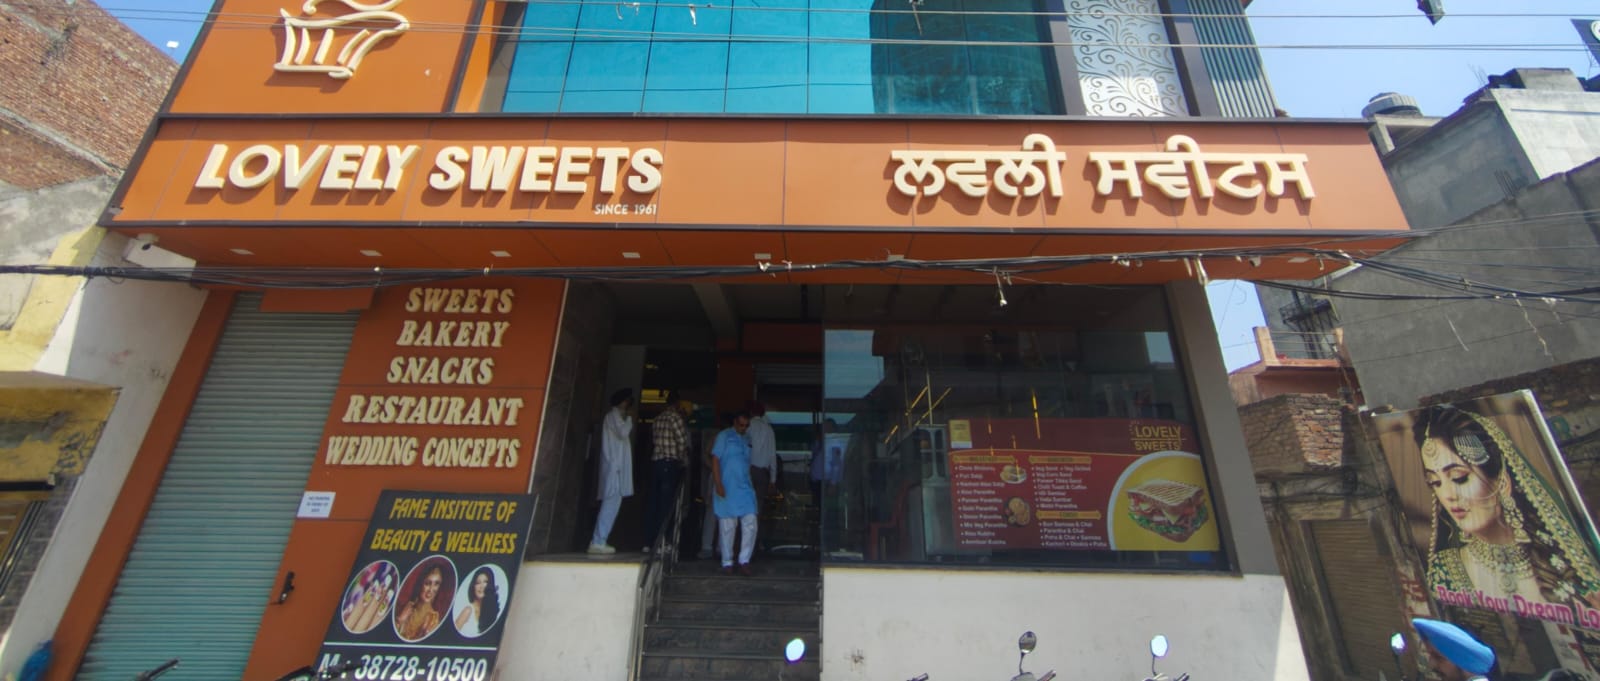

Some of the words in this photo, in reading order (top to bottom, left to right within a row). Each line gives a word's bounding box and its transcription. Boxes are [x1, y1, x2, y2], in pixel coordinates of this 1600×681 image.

[195, 143, 421, 191] LOVELY
[428, 146, 664, 194] SWEETS
[891, 133, 1067, 199] ਲਵਲੀ
[1088, 134, 1317, 200] ਸਵੀਟਸ
[594, 203, 629, 216] SINCE
[633, 203, 658, 216] 1961
[405, 287, 515, 314] SWEETS
[396, 320, 510, 348] BAKERY
[386, 356, 495, 385] SNACKS
[342, 394, 524, 427] RESTAURANT
[1135, 425, 1181, 438] LOVELY
[1135, 440, 1181, 451] SWEETS
[325, 436, 420, 466] WEDDING
[422, 437, 521, 468] CONCEPTS
[389, 498, 431, 520] FAME
[431, 499, 495, 521] INSITUTE
[496, 501, 517, 523] OF
[370, 529, 430, 553] BEAUTY
[430, 532, 443, 552] &
[446, 532, 518, 555] WELLNESS
[1437, 585, 1473, 608] Book
[1474, 590, 1510, 613] Your
[1512, 595, 1574, 624] Dream
